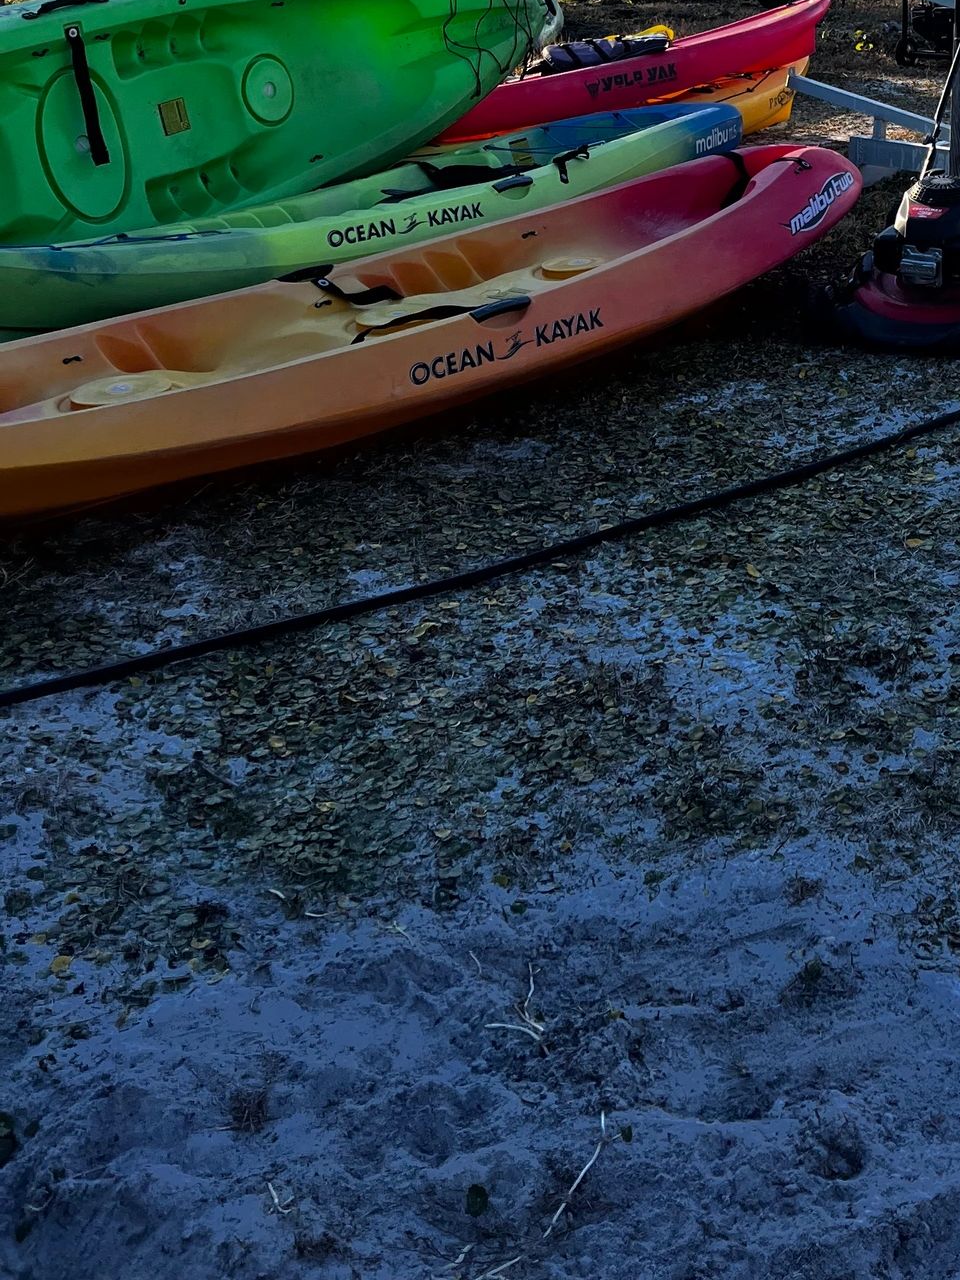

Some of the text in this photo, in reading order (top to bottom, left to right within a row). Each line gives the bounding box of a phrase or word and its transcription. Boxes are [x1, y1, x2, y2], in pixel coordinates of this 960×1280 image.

[601, 63, 678, 92] YOLO YAK
[695, 127, 729, 155] malibu
[327, 201, 485, 248] OCEAN KAYAK
[790, 171, 854, 235] malibu two
[409, 307, 605, 386] OCEAN KAYAK
